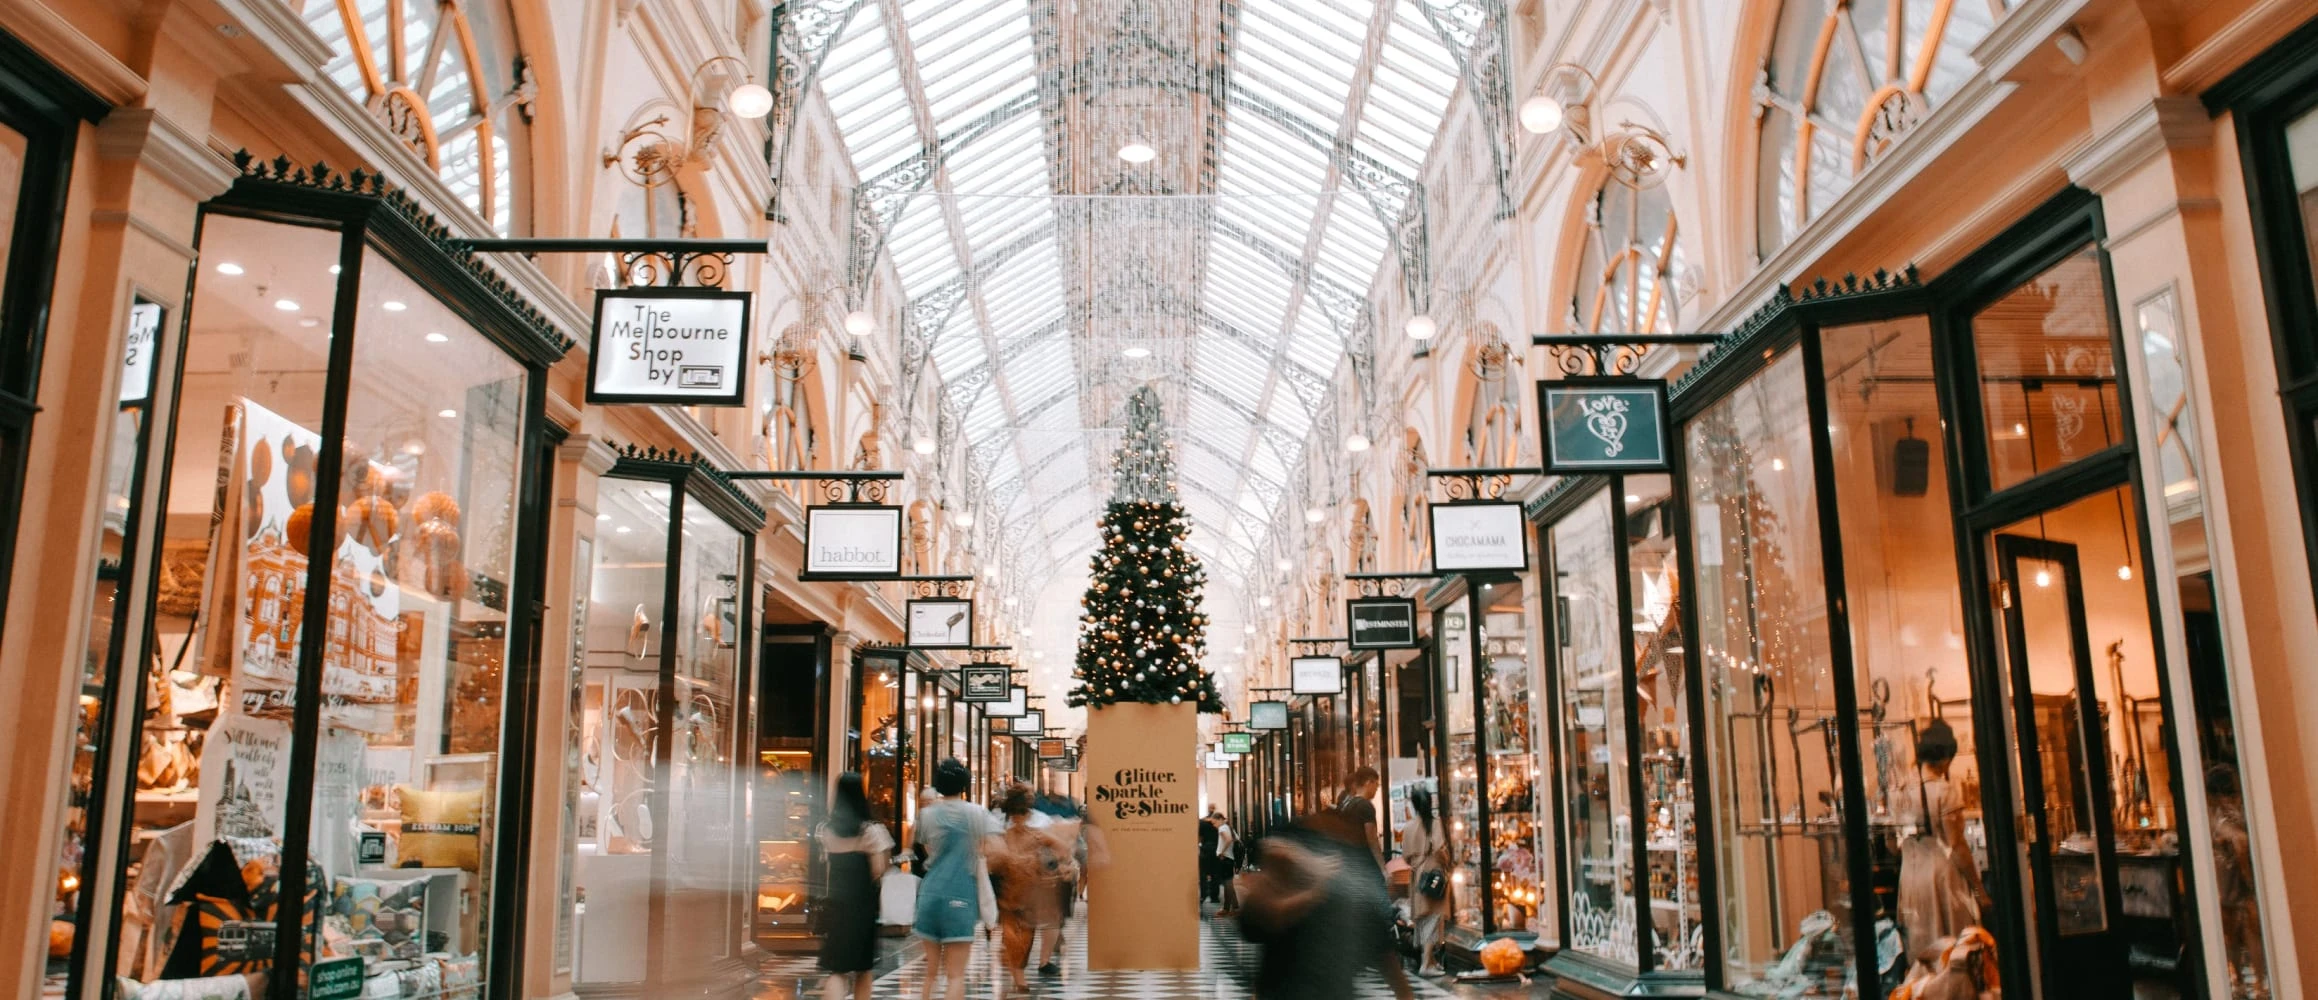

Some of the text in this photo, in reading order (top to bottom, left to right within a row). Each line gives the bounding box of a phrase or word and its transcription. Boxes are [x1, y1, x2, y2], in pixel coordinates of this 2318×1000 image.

[634, 305, 671, 322] The
[611, 321, 729, 340] Melbourne
[629, 342, 683, 366] Shop
[649, 368, 674, 385] by
[821, 546, 886, 562] habbot.
[1115, 768, 1176, 786] Glitter.
[1096, 784, 1163, 802] Sparkle
